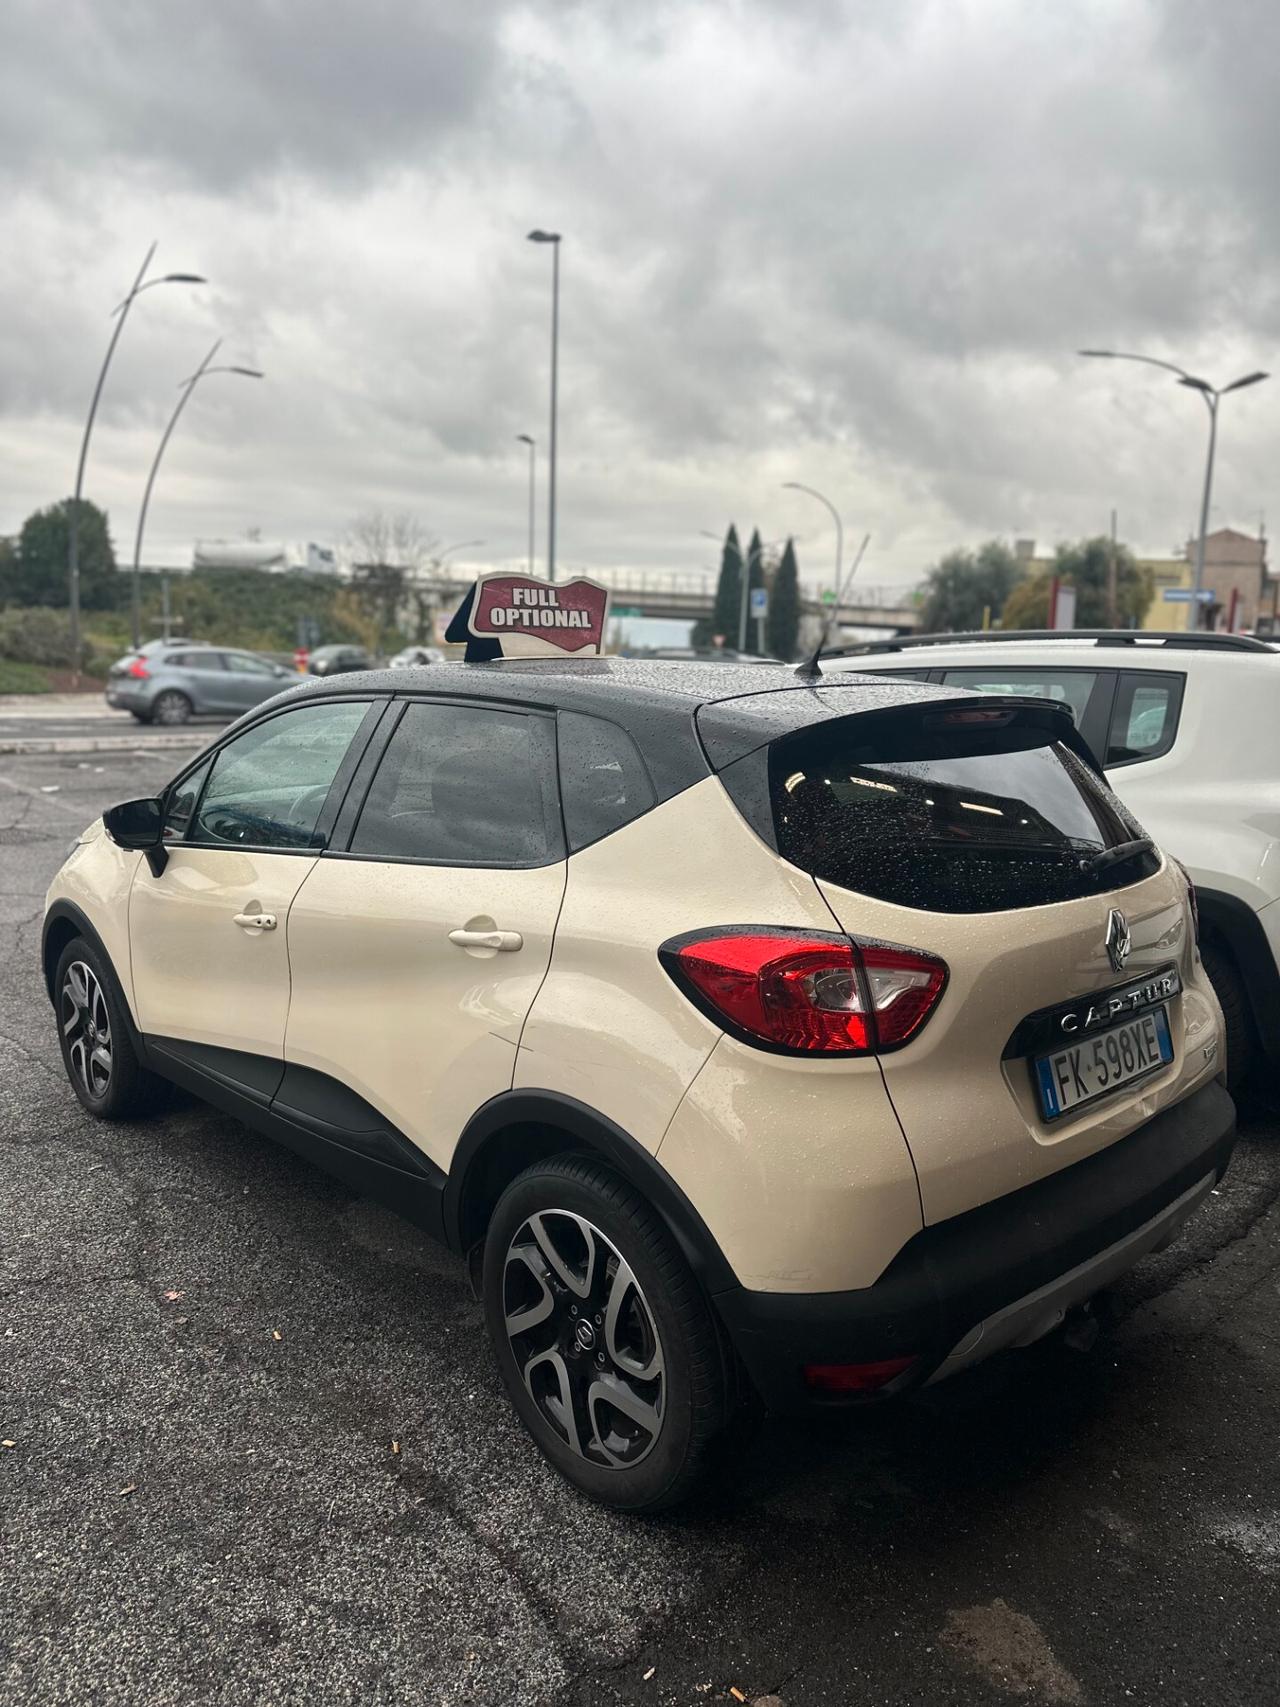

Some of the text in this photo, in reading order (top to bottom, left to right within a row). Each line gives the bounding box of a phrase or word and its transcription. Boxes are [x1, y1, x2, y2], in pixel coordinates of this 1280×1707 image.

[512, 588, 559, 607] FULL
[490, 607, 592, 628] OPTIONAL
[1060, 978, 1171, 1032] CAPTUR
